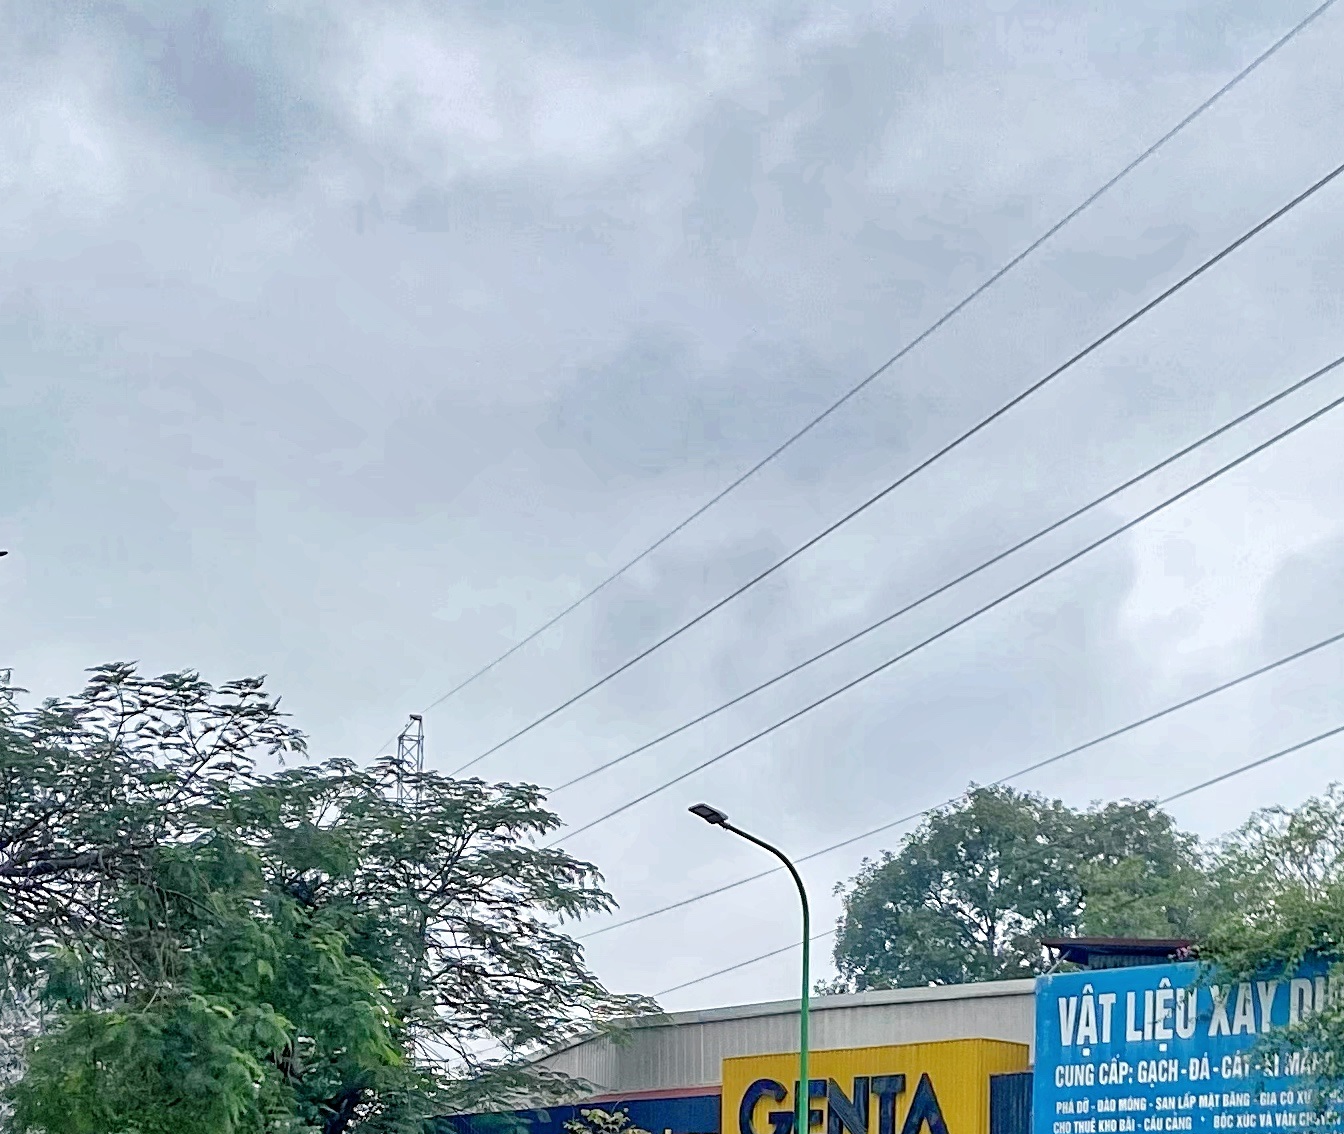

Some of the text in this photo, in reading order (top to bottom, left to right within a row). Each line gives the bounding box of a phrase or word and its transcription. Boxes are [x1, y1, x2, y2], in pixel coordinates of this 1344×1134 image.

[1058, 983, 1117, 1057] VẬT
[1125, 977, 1198, 1052] LIỆU
[1055, 1062, 1095, 1088] CUNG
[1098, 1053, 1133, 1086] CẤP:
[1137, 1057, 1179, 1088] GẠCH
[1188, 1051, 1211, 1081] ĐÁ
[1155, 1095, 1176, 1111] SAN
[1177, 1090, 1197, 1110] LẤP
[1259, 1091, 1277, 1106] GIA
[1053, 1121, 1072, 1134] CHO
[1073, 1117, 1096, 1134] THUÊ
[1098, 1118, 1117, 1133] KHO
